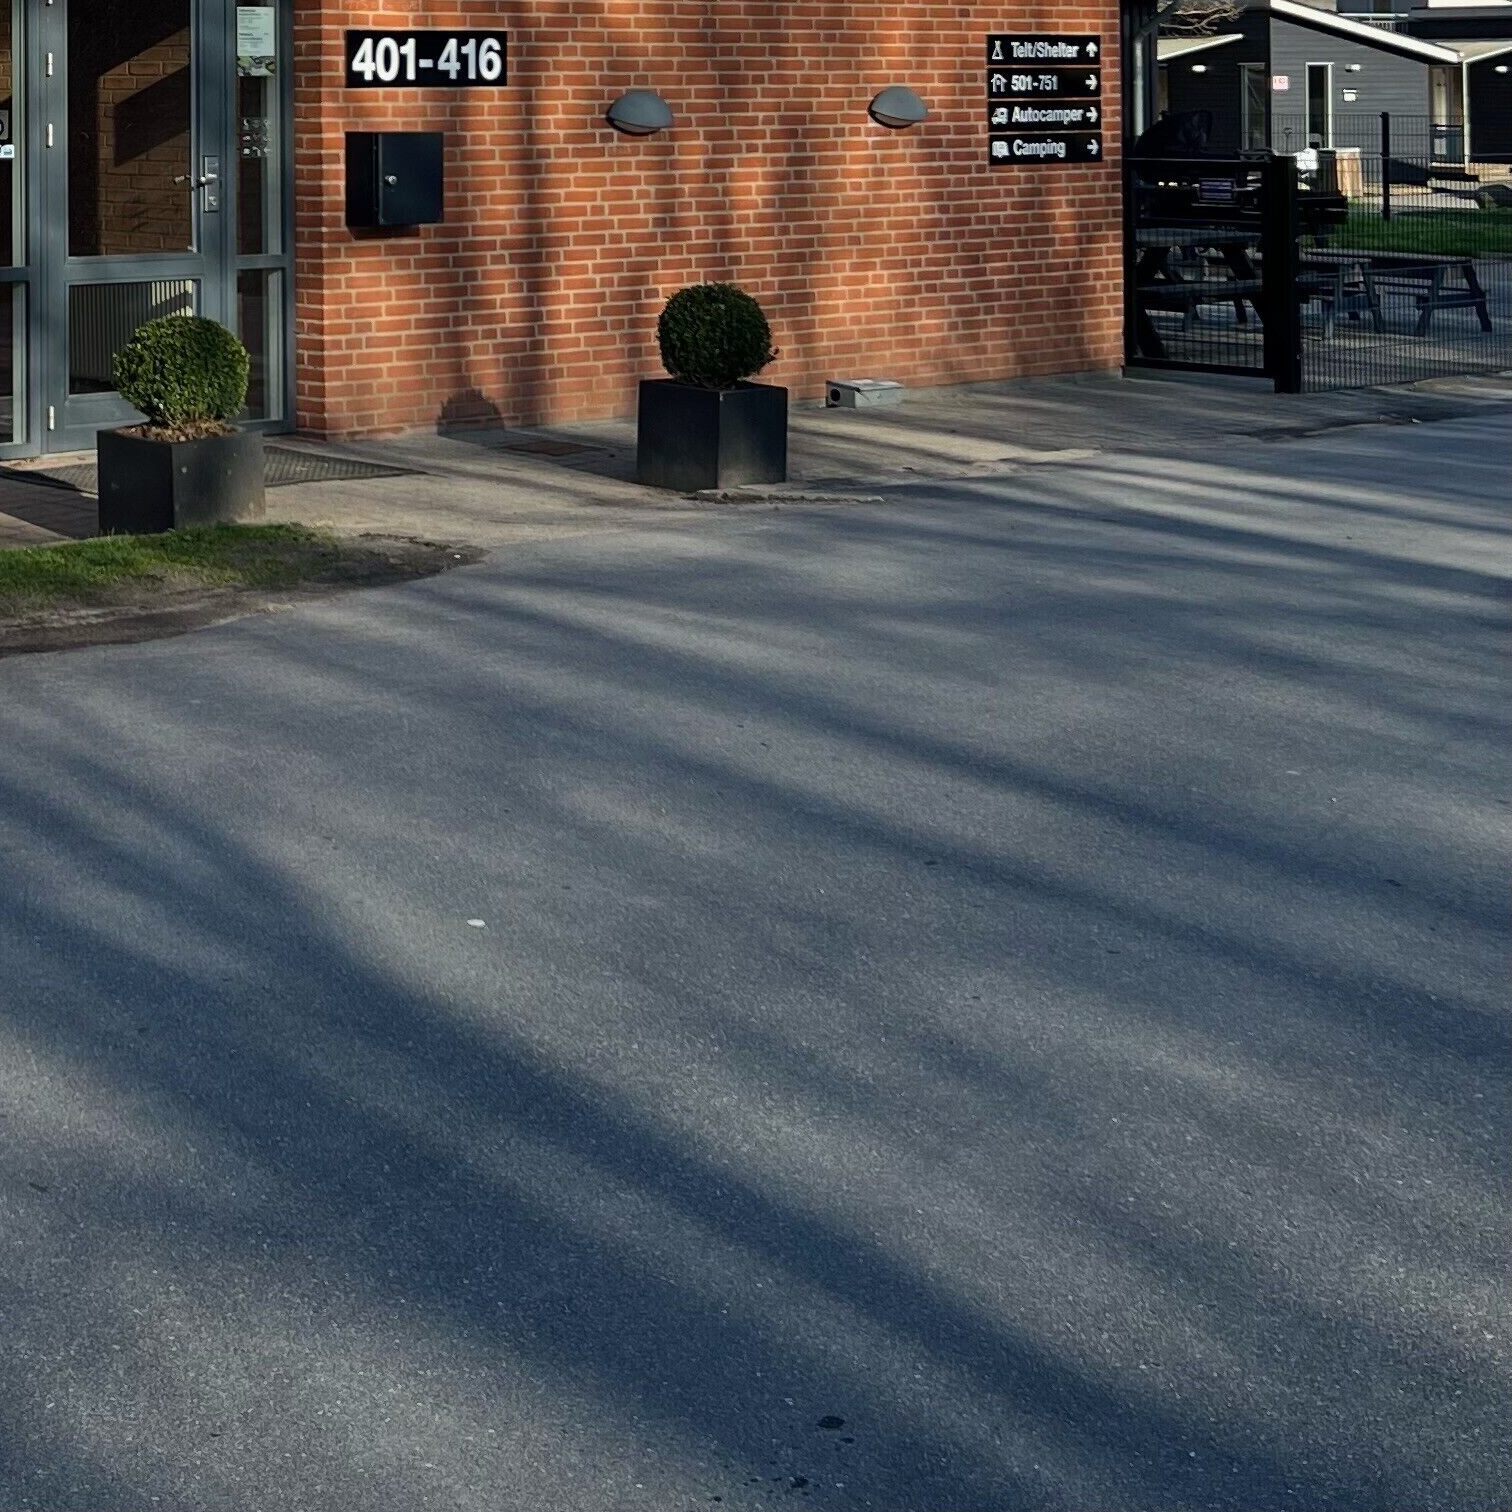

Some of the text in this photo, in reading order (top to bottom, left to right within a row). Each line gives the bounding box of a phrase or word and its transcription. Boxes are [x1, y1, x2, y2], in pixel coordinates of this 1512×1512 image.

[351, 37, 502, 81] 401-416
[1010, 41, 1080, 58] Telt/Shelter
[1010, 75, 1059, 91] 501-751
[1011, 106, 1084, 125] Autocamper
[1013, 139, 1066, 158] Camping
